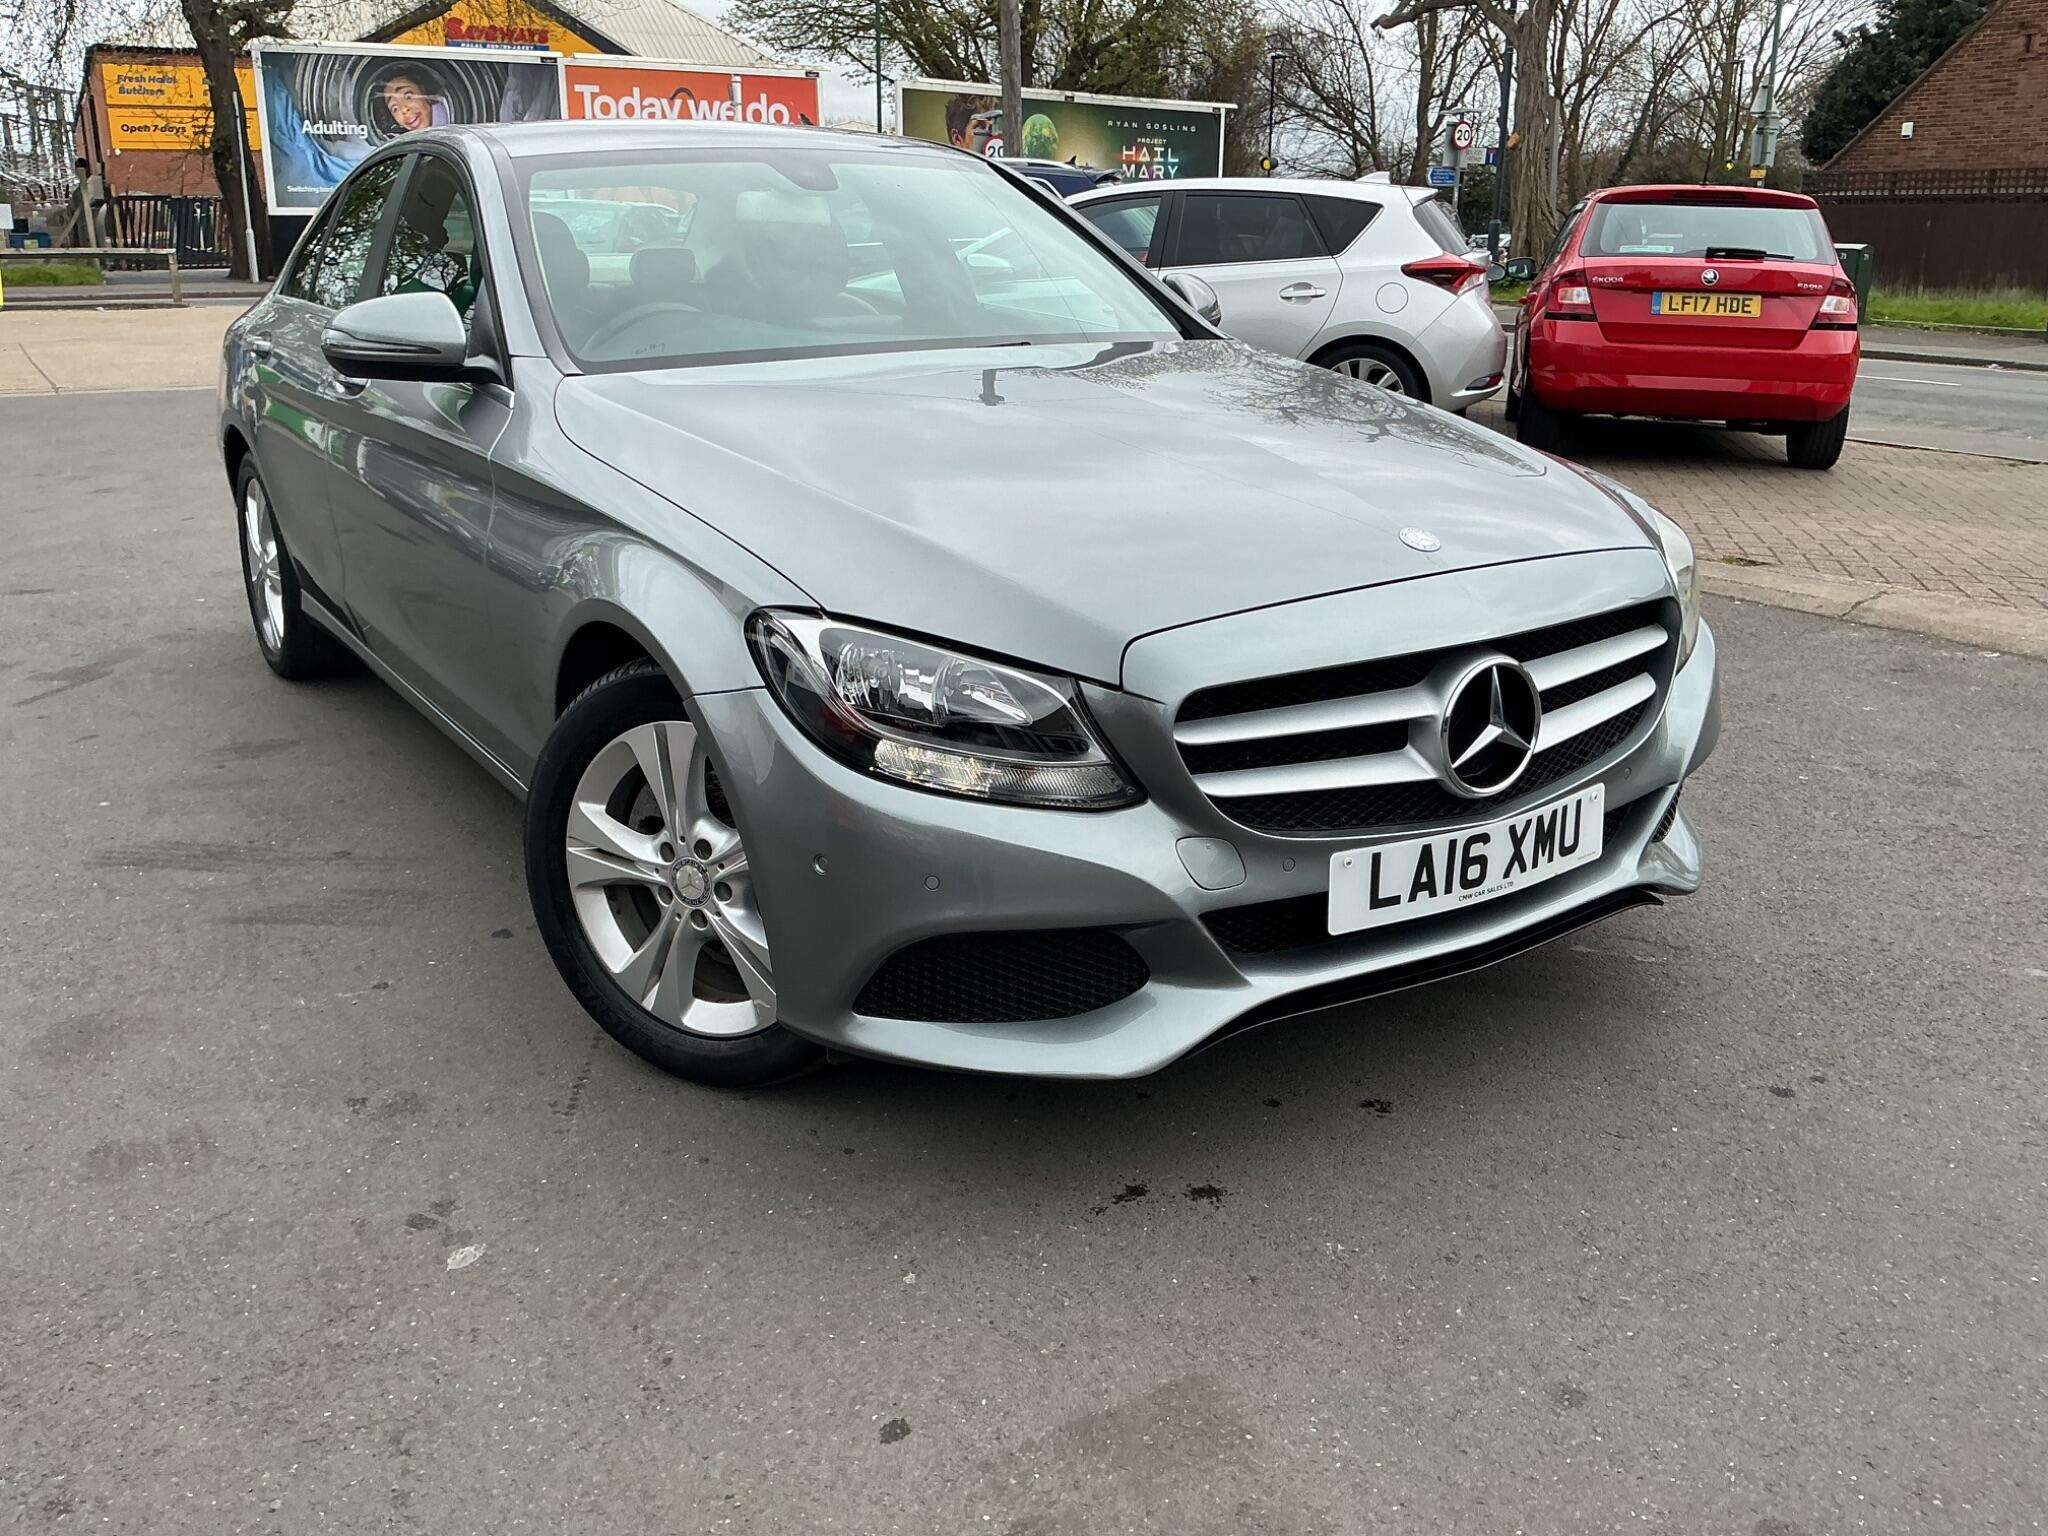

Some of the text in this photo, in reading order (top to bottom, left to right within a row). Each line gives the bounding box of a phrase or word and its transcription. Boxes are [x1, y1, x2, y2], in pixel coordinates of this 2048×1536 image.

[574, 84, 684, 120] Today
[120, 123, 151, 133] Open
[302, 119, 368, 139] Adulting
[1107, 120, 1197, 132] RYAN GOSLING
[1457, 129, 1470, 141] 20
[1122, 145, 1179, 162] HAIL
[1121, 163, 1178, 179] MARY
[1668, 295, 1711, 312] LF17
[1716, 297, 1753, 314] HDE
[1369, 798, 1582, 910] LA16 XMU
[1474, 889, 1486, 898] CAR
[1486, 884, 1504, 895] SALES
[1503, 881, 1514, 889] LTD
